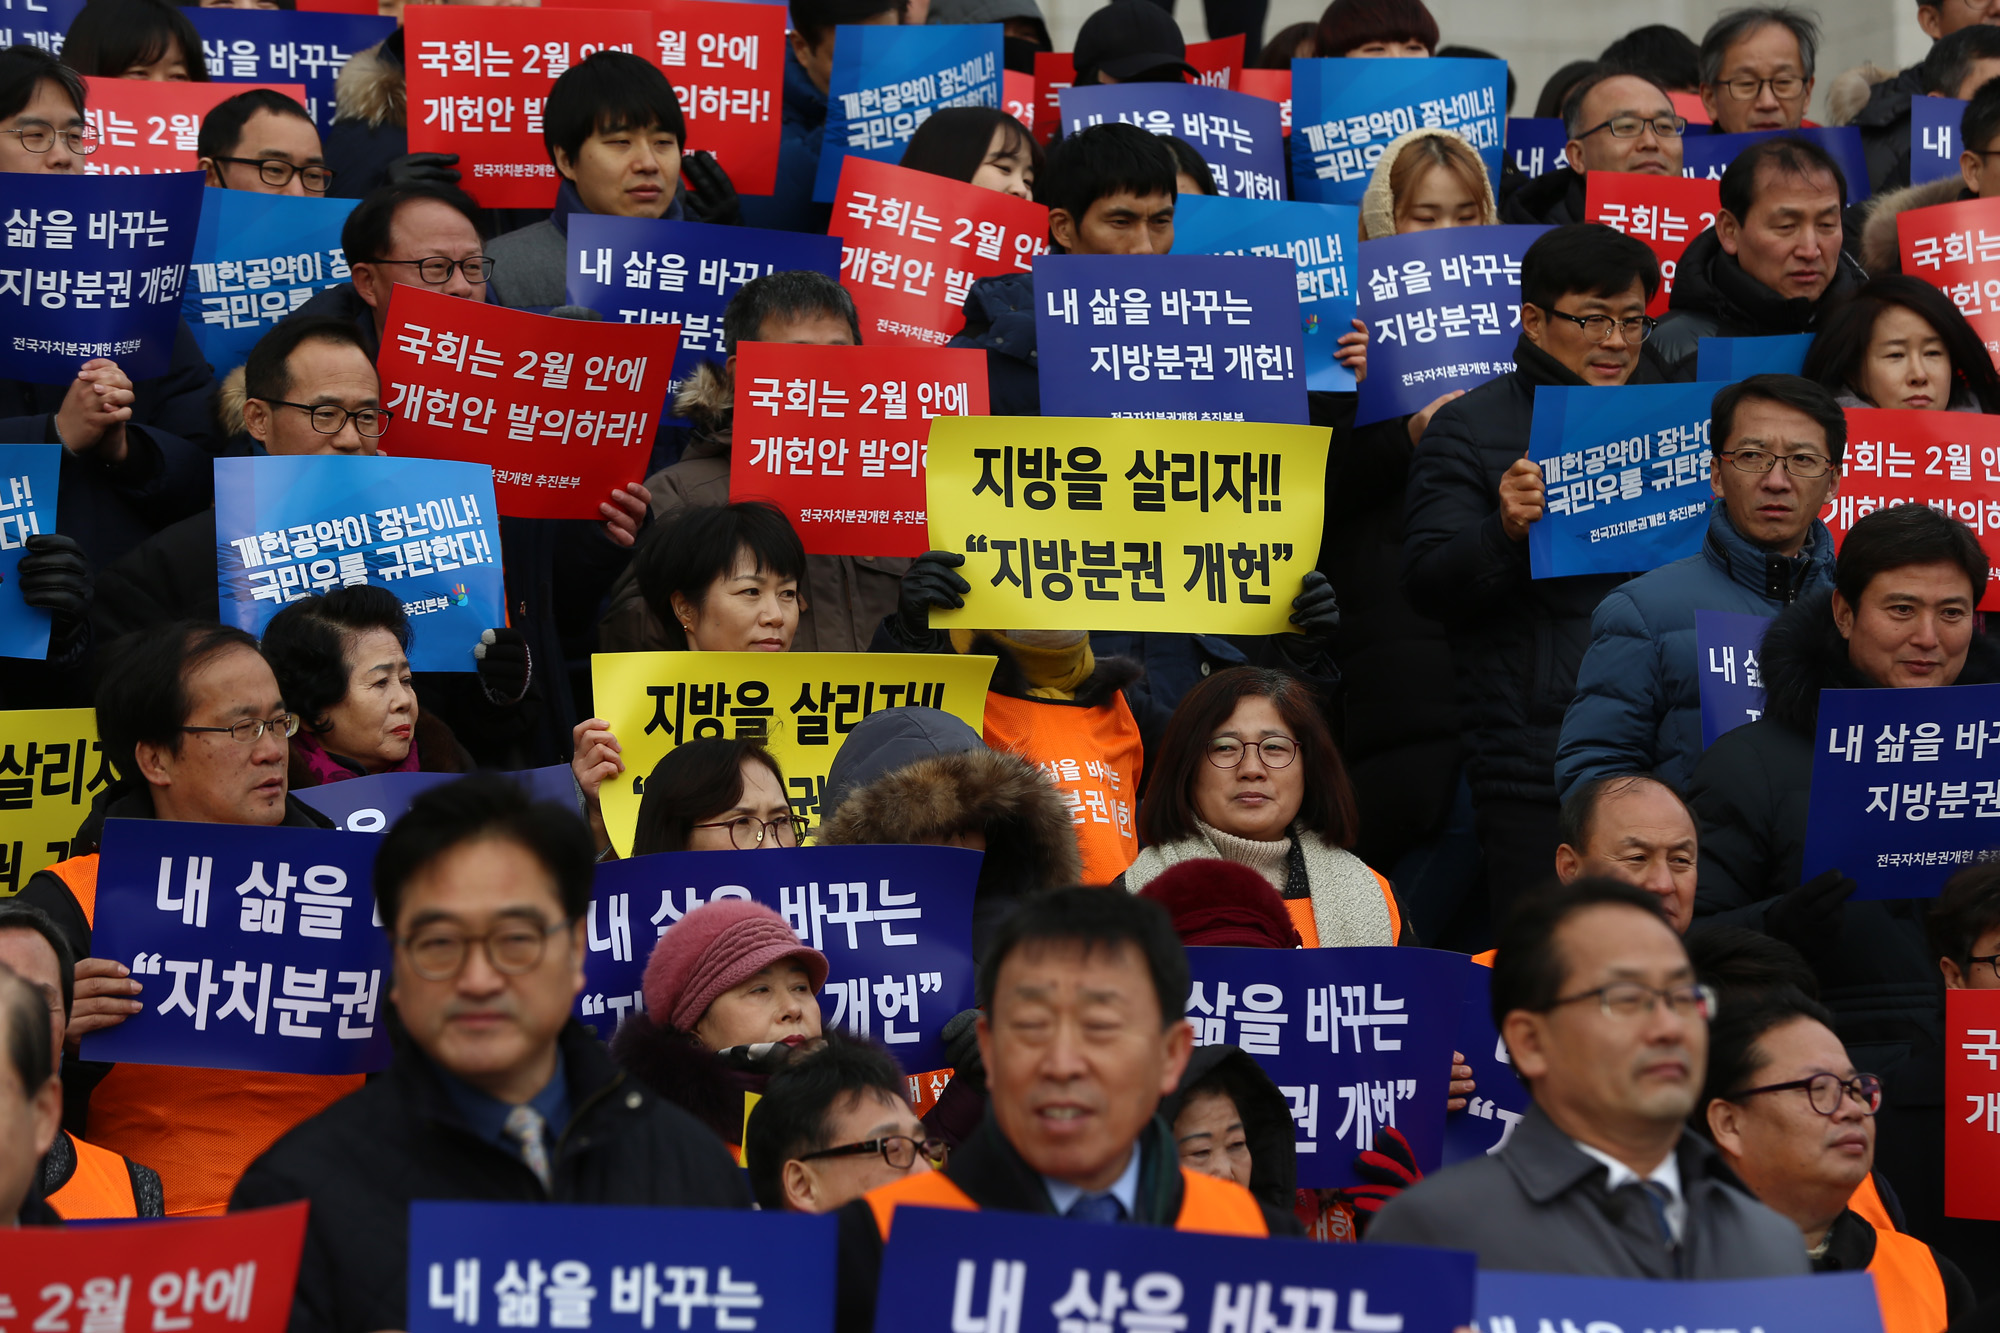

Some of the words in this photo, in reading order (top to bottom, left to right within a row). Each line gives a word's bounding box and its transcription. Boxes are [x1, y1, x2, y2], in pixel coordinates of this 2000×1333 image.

[203, 40, 260, 77] 삶을
[418, 41, 513, 77] 국회는
[522, 42, 570, 78] 2월
[697, 33, 758, 70] 안에
[839, 74, 937, 120] 개헌공약이
[938, 51, 995, 98] 장난이냐!
[147, 114, 199, 151] 2월
[424, 96, 515, 132] 개헌안
[1182, 112, 1254, 154] 바꾸는
[1301, 106, 1417, 152] 개헌공약이
[1420, 86, 1496, 129] 장난이냐!
[1516, 147, 1544, 179] 내
[1923, 126, 1951, 160] 내
[473, 163, 556, 177] 전국자치분권개헌
[4, 209, 78, 250] 삶을
[88, 209, 169, 250] 바꾸는
[846, 191, 942, 243] 국회는
[950, 217, 1006, 261] 2월
[1014, 234, 1051, 272] 안
[1599, 203, 1689, 243] 국회는
[580, 248, 612, 285] 내
[623, 251, 689, 292] 삶을
[840, 246, 935, 296] 개헌안
[1912, 230, 2000, 271] 국회는
[0, 268, 132, 310] 지방분권
[138, 264, 186, 306] 개헌!
[190, 252, 322, 293] 개헌공약이
[1368, 260, 1432, 302] 삶을
[1440, 254, 1522, 287] 바꾸는
[1047, 289, 1079, 326] 내
[1089, 288, 1152, 326] 삶을
[1161, 290, 1253, 327] 바꾸는
[1375, 302, 1501, 347] 지방분권
[13, 337, 112, 358] 전국자치분권개헌
[113, 338, 141, 355] 추진본부
[397, 323, 504, 378] 국회는
[513, 350, 574, 391] 2월
[584, 356, 648, 392] 안에
[1091, 344, 1215, 382] 지방분권
[1225, 345, 1295, 382] 개헌!
[1402, 361, 1490, 387] 전국자치분권개헌
[387, 382, 497, 435] 개헌안
[507, 404, 648, 447] 발의하라!
[749, 378, 849, 418] 국회는
[859, 381, 907, 420] 2월
[917, 382, 969, 419] 안에
[749, 437, 849, 476] 개헌안
[859, 439, 929, 478] 발의
[1539, 434, 1650, 485] 개헌공약이
[1925, 444, 1971, 481] 2월
[535, 474, 581, 489] 추진본부
[972, 446, 1107, 512] 지방을
[1124, 449, 1281, 513] 살리자!!
[1547, 467, 1643, 516] 국민우롱
[231, 513, 372, 569] 개헌공약이
[374, 494, 482, 543] 장난이냐!
[800, 509, 890, 524] 전국자치분권개헌
[892, 510, 928, 525] 추진본
[1590, 512, 1667, 543] 전국자치분권개헌
[1668, 502, 1706, 522] 추진본부
[375, 530, 493, 582] 규탄한다!
[965, 533, 1165, 602] “지방분권
[1183, 542, 1293, 605] 개헌”
[402, 596, 449, 617] 추진본부
[1709, 646, 1736, 685] 내
[644, 681, 774, 746] 지방을
[1829, 725, 1864, 763] 내
[1875, 723, 1944, 763] 삶을
[1865, 779, 2000, 822] 지방분권
[1876, 851, 1973, 868] 전국자치분권개헌
[156, 856, 213, 928] 내
[236, 862, 352, 940] 삶을
[587, 893, 632, 962] 내
[780, 879, 922, 951] 바꾸는
[132, 952, 381, 1041] “자치분권
[824, 971, 943, 1044] 개헌”
[1186, 981, 1288, 1056] 삶을
[1306, 984, 1409, 1054] 바꾸는
[33, 1276, 131, 1333] 2월
[149, 1261, 257, 1331] 안에
[429, 1258, 481, 1325] 내
[495, 1259, 597, 1329] 삶을
[610, 1262, 763, 1331] 바꾸는
